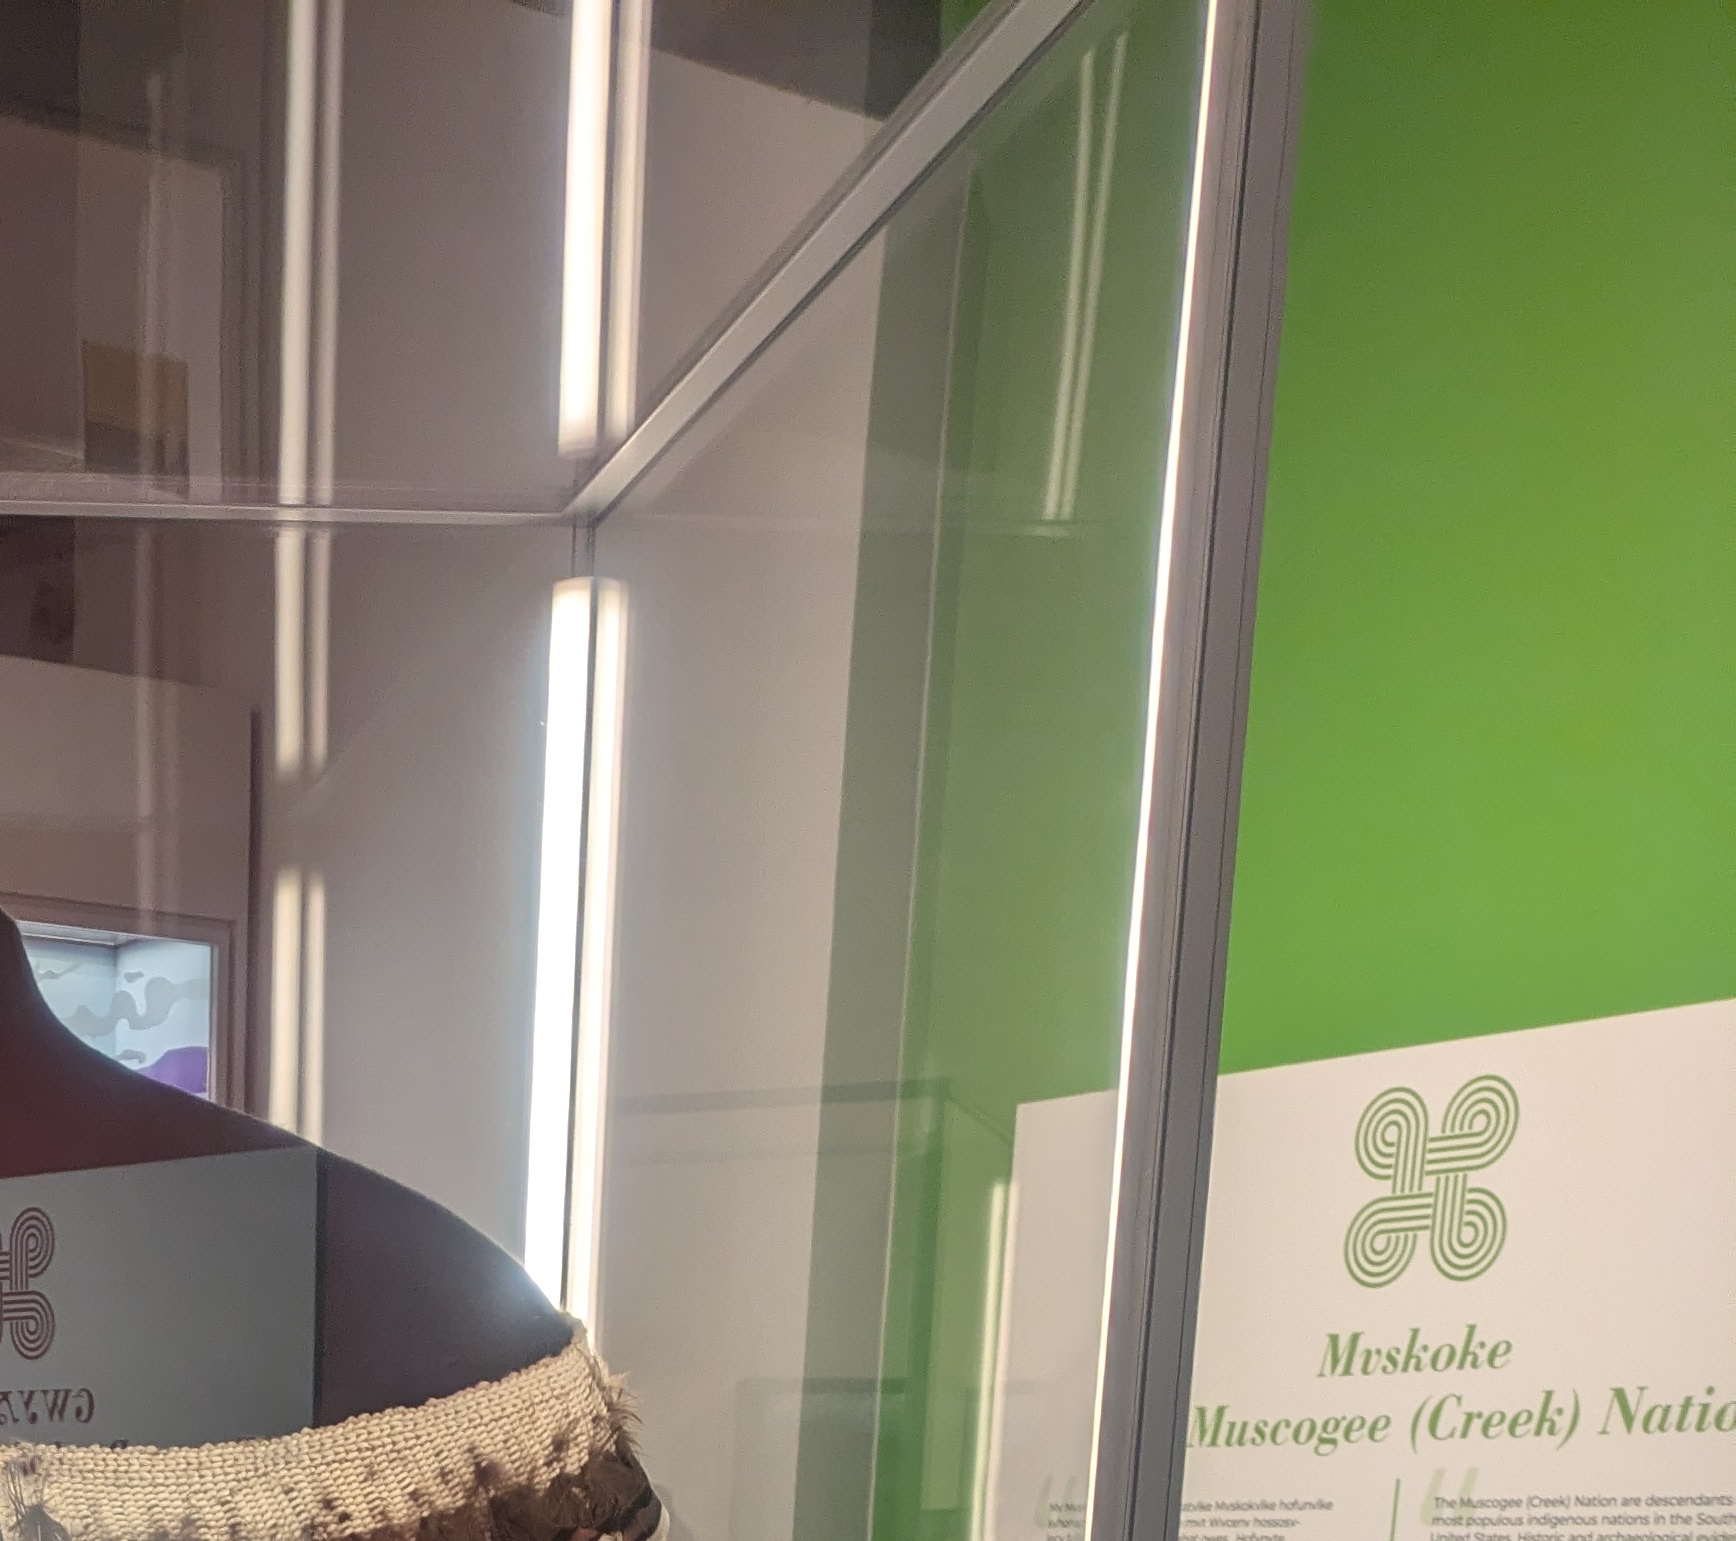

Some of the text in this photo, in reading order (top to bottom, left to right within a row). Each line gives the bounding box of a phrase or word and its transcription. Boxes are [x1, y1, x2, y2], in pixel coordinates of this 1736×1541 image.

[1317, 1325, 1512, 1377] Mvskoke
[1186, 1405, 1391, 1456] Muscogee
[1411, 1388, 1581, 1455] (Creek)
